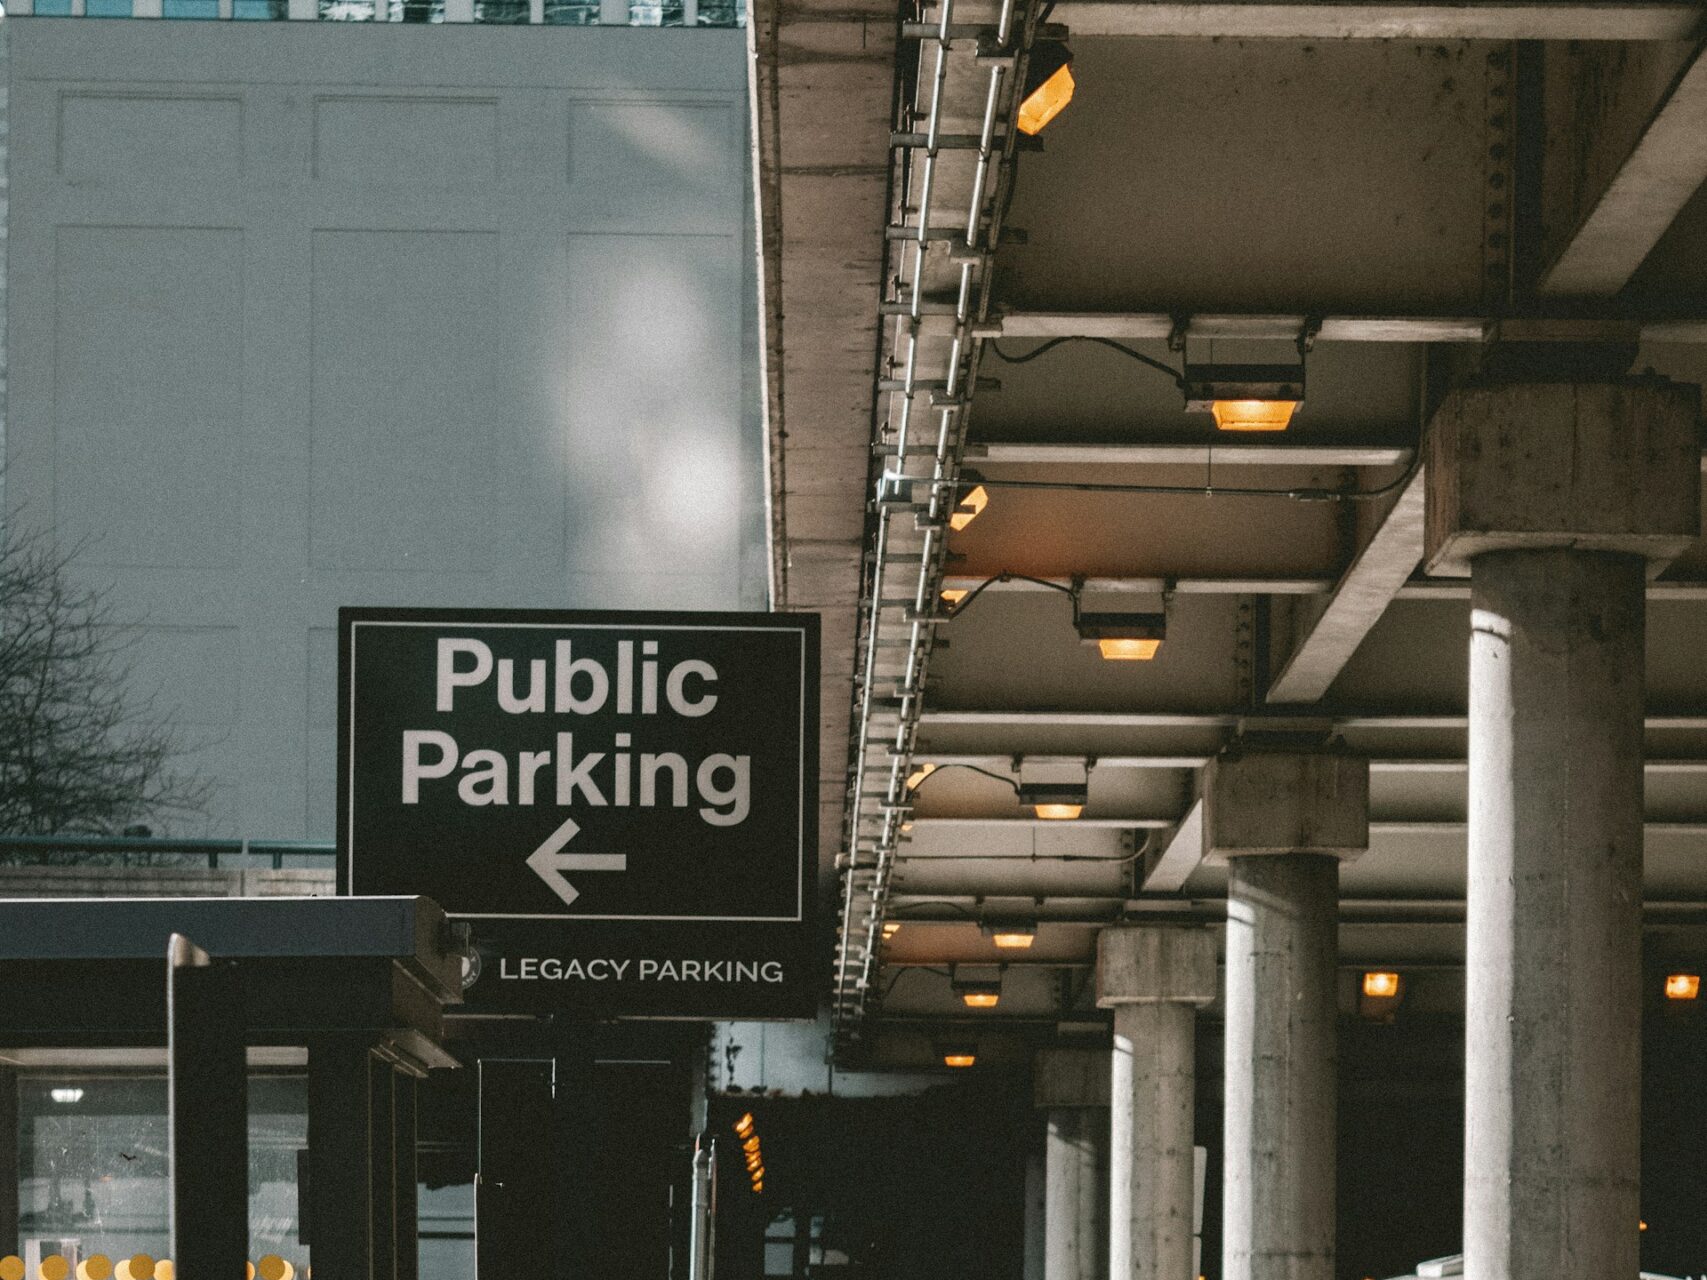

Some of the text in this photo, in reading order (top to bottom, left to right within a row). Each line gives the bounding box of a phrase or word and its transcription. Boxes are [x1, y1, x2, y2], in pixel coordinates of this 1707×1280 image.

[436, 637, 718, 717] Public
[402, 729, 751, 827] Parking
[500, 957, 631, 981] LEGACY
[639, 959, 784, 983] PARKING
